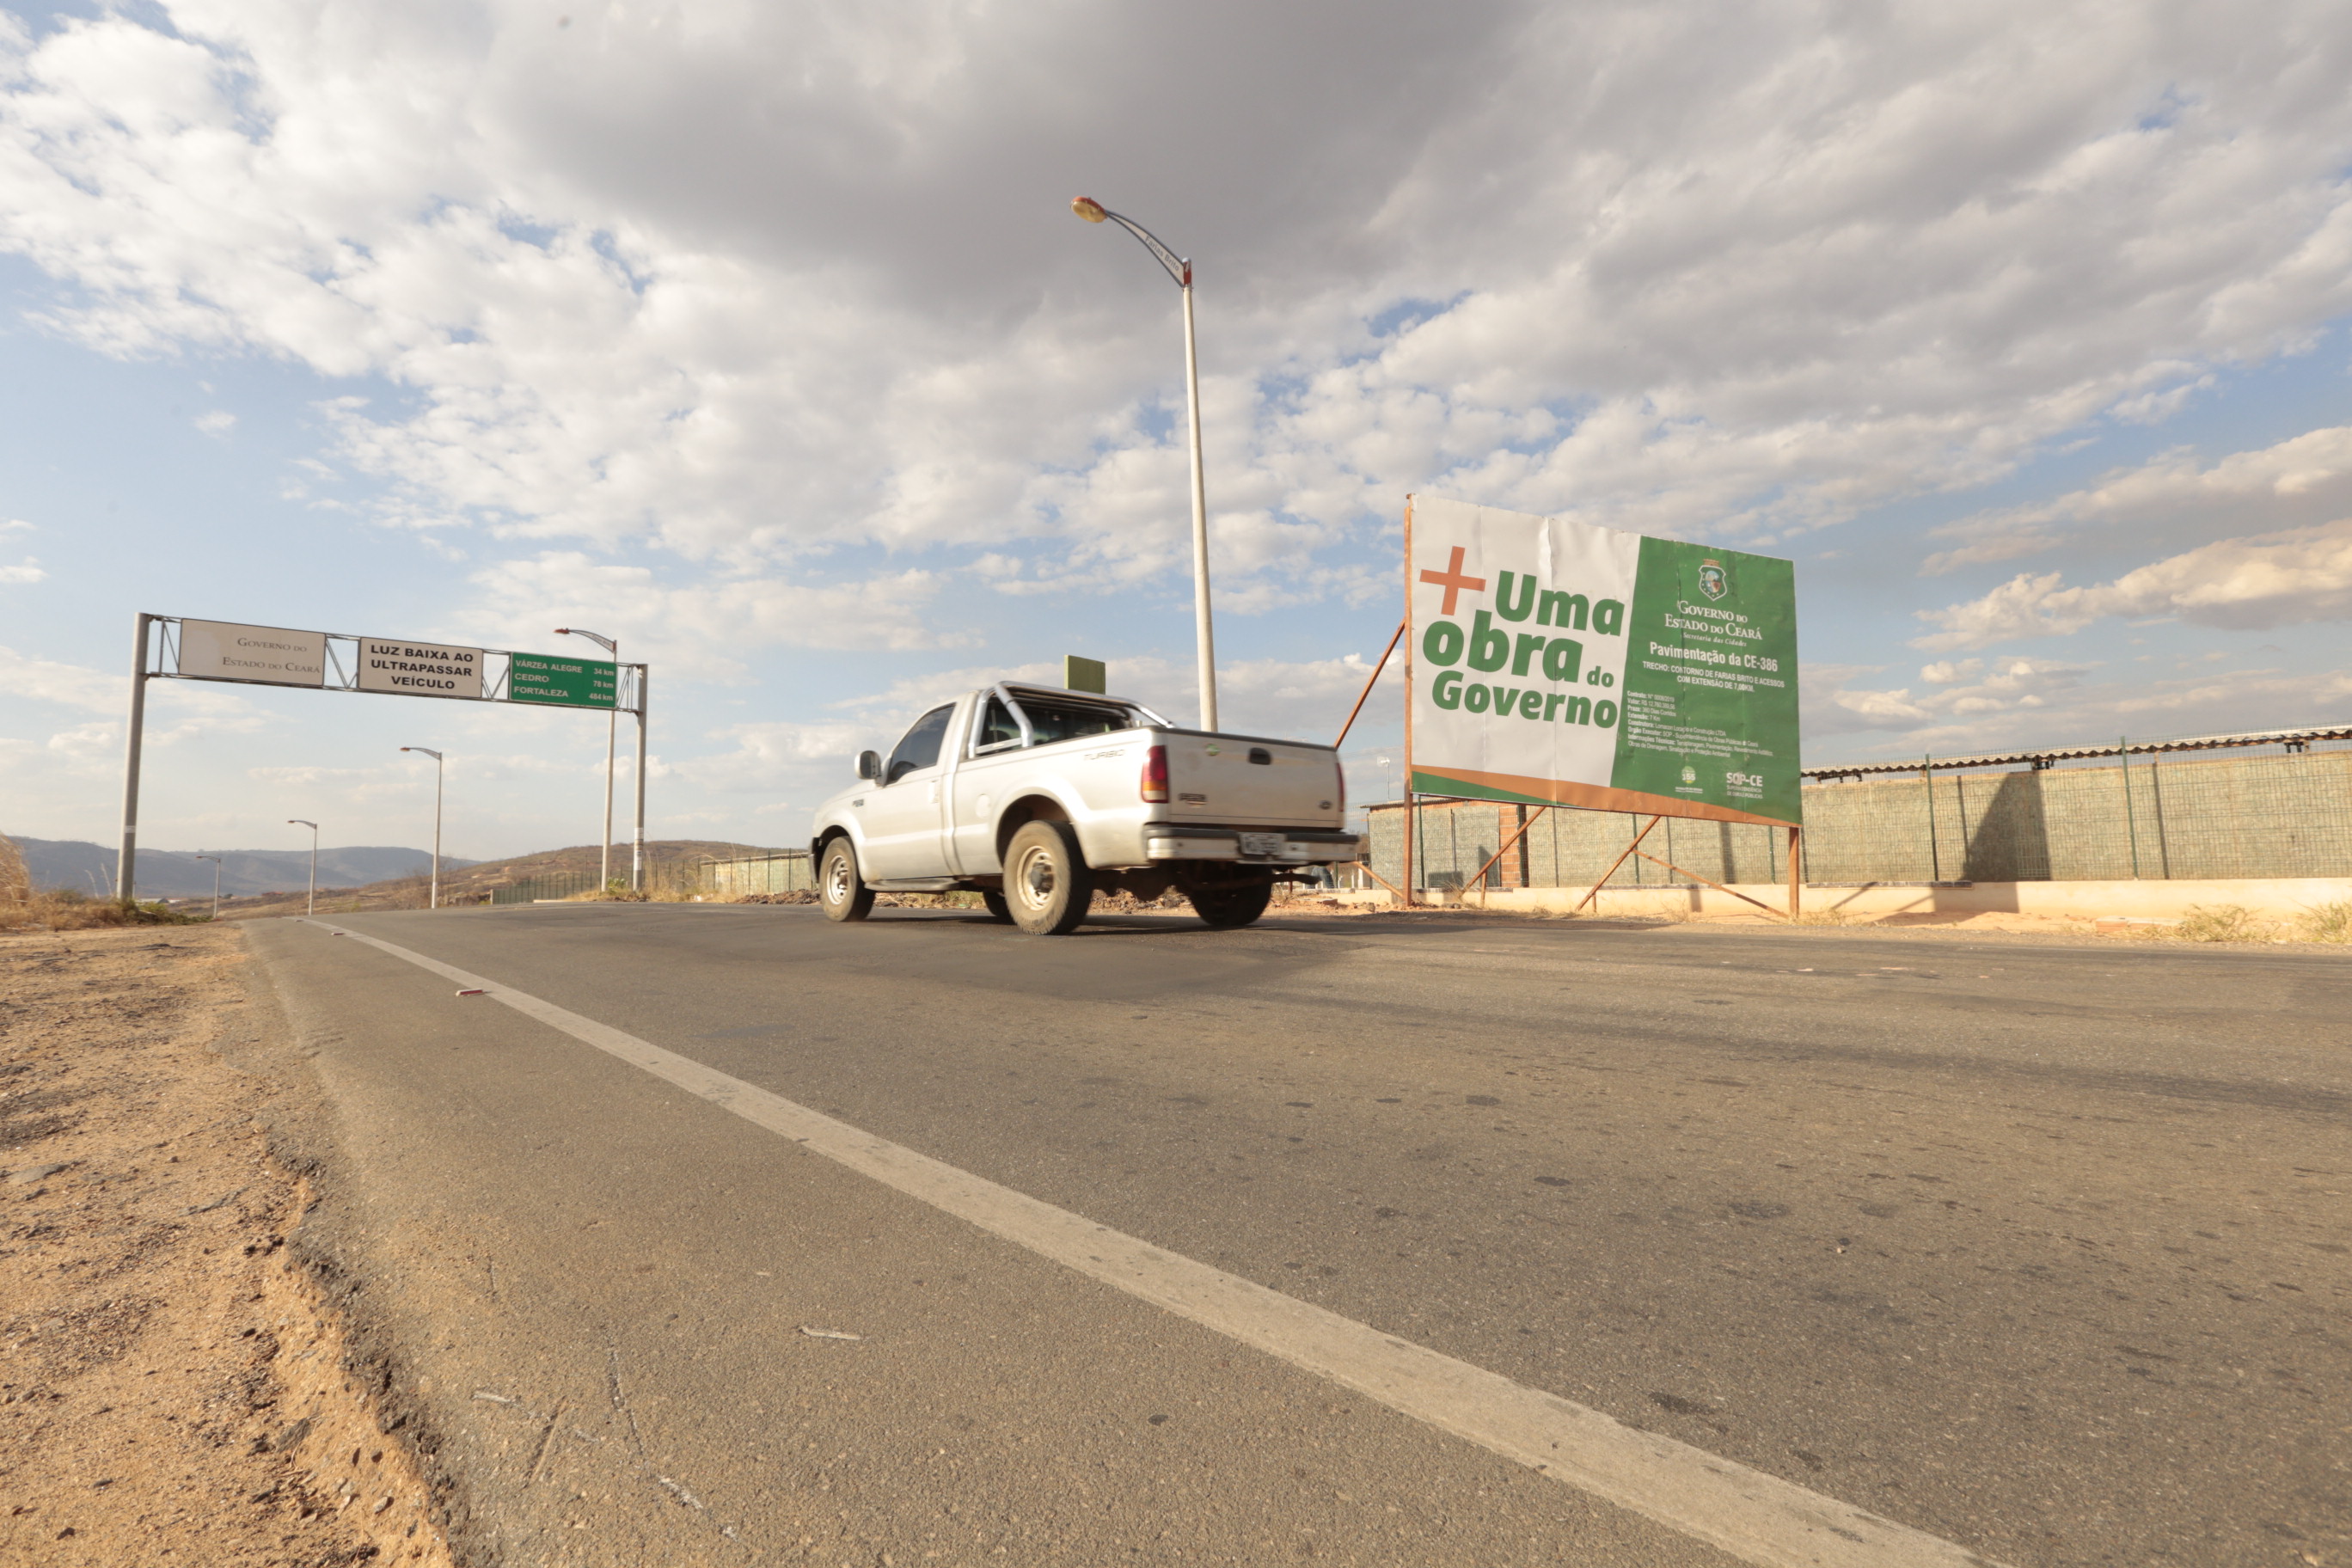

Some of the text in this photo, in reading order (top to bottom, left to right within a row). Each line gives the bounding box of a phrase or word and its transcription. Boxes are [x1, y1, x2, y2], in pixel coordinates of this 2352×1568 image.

[1144, 236, 1179, 272] Farias Brito
[1495, 570, 1625, 637] Uma
[1677, 600, 1748, 623] GOVERNO DO
[1664, 613, 1762, 640] ESTADO DO CEARÁ
[237, 637, 291, 651] GOVERNO
[1683, 632, 1712, 642] Secretaria
[1724, 638, 1747, 646] Cidades
[371, 645, 474, 662] LUZ BAIXA AO
[1423, 609, 1614, 688] obra do
[1650, 641, 1778, 672] Pavimentação da CE-386
[223, 657, 266, 669] ESTADO
[285, 662, 321, 673] CEARÁ
[371, 659, 472, 677] ULTRAPASSAR
[516, 659, 548, 670] VÁRZEA
[550, 664, 583, 673] ALEGRE
[391, 676, 455, 689] VEÍCULO
[514, 673, 549, 683] CEDRO
[1643, 661, 1670, 672] TRECHO:
[1671, 665, 1705, 677] CONTORNO
[1715, 671, 1736, 682] FARIAS
[1736, 675, 1754, 683] BRITO
[1759, 677, 1785, 688] ACESSOS
[1677, 675, 1691, 683] COM
[1692, 677, 1724, 688] EXTENSÃO
[514, 686, 568, 697] FORTALEZA
[1432, 670, 1618, 728] Governo
[1726, 772, 1763, 787] SOP-CE
